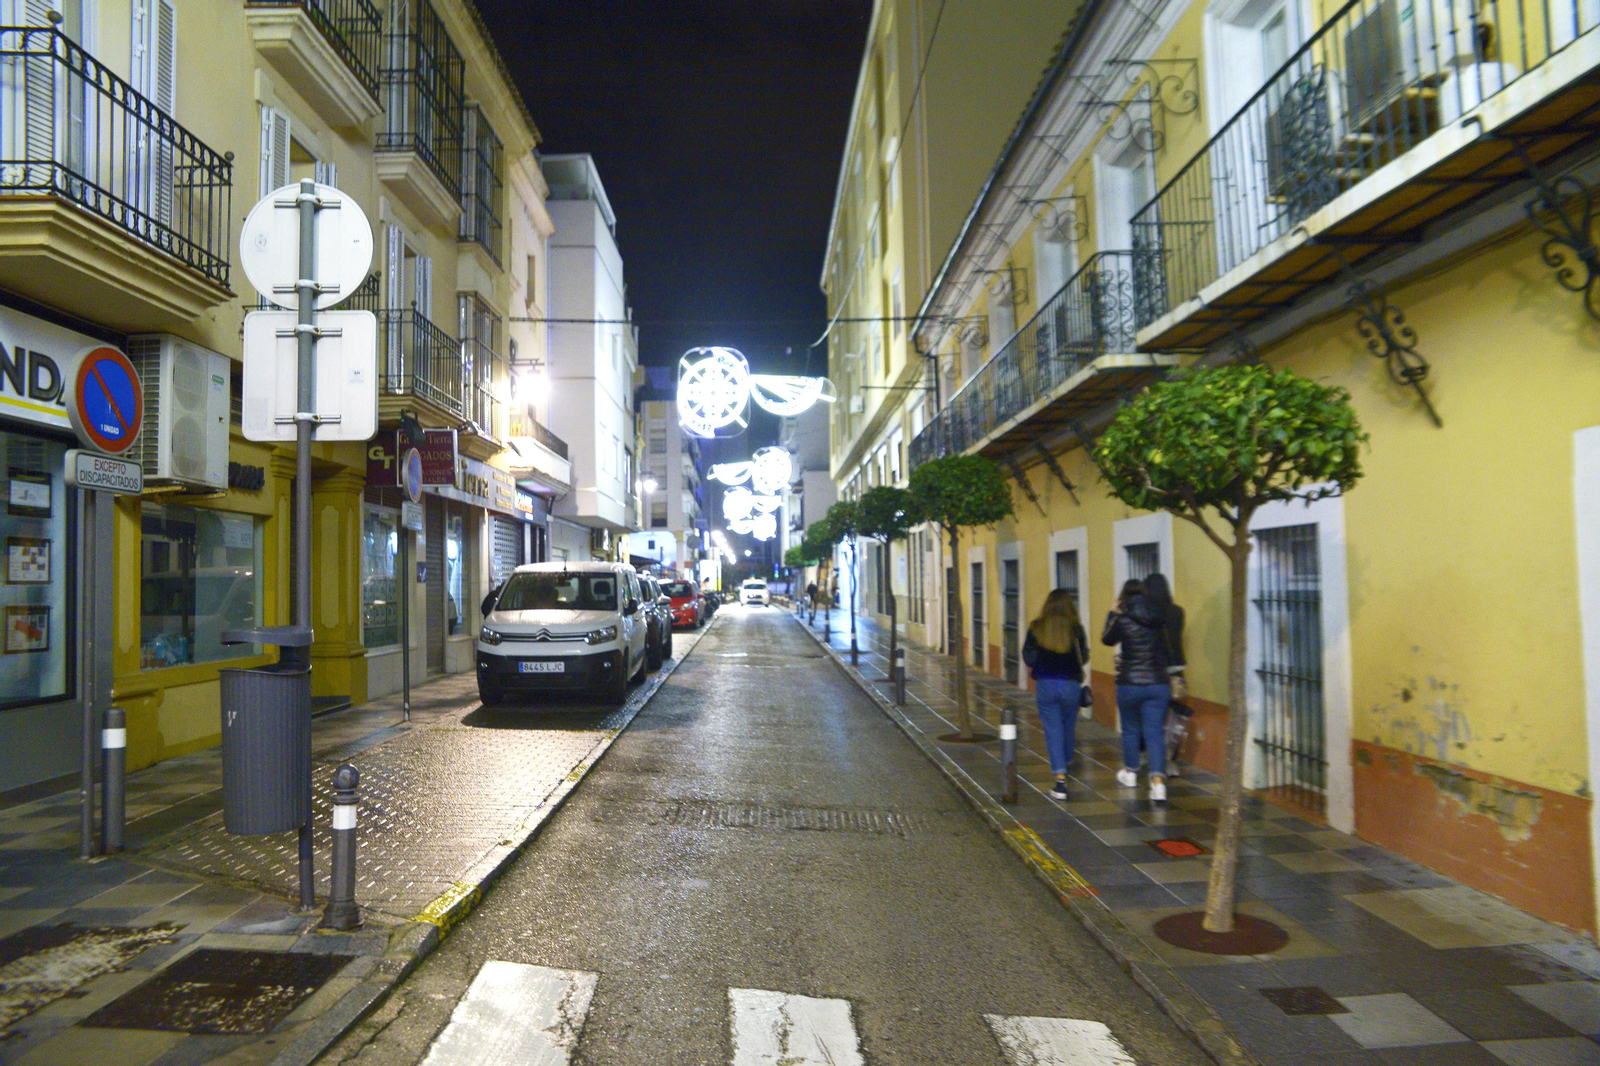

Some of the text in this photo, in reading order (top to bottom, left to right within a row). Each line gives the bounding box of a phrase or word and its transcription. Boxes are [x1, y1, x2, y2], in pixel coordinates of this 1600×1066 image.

[104, 424, 120, 435] UNIDAD
[94, 459, 127, 475] EXCEPTO
[80, 469, 139, 489] DISCAPACITADOS
[524, 663, 563, 671] 8445 LJC
